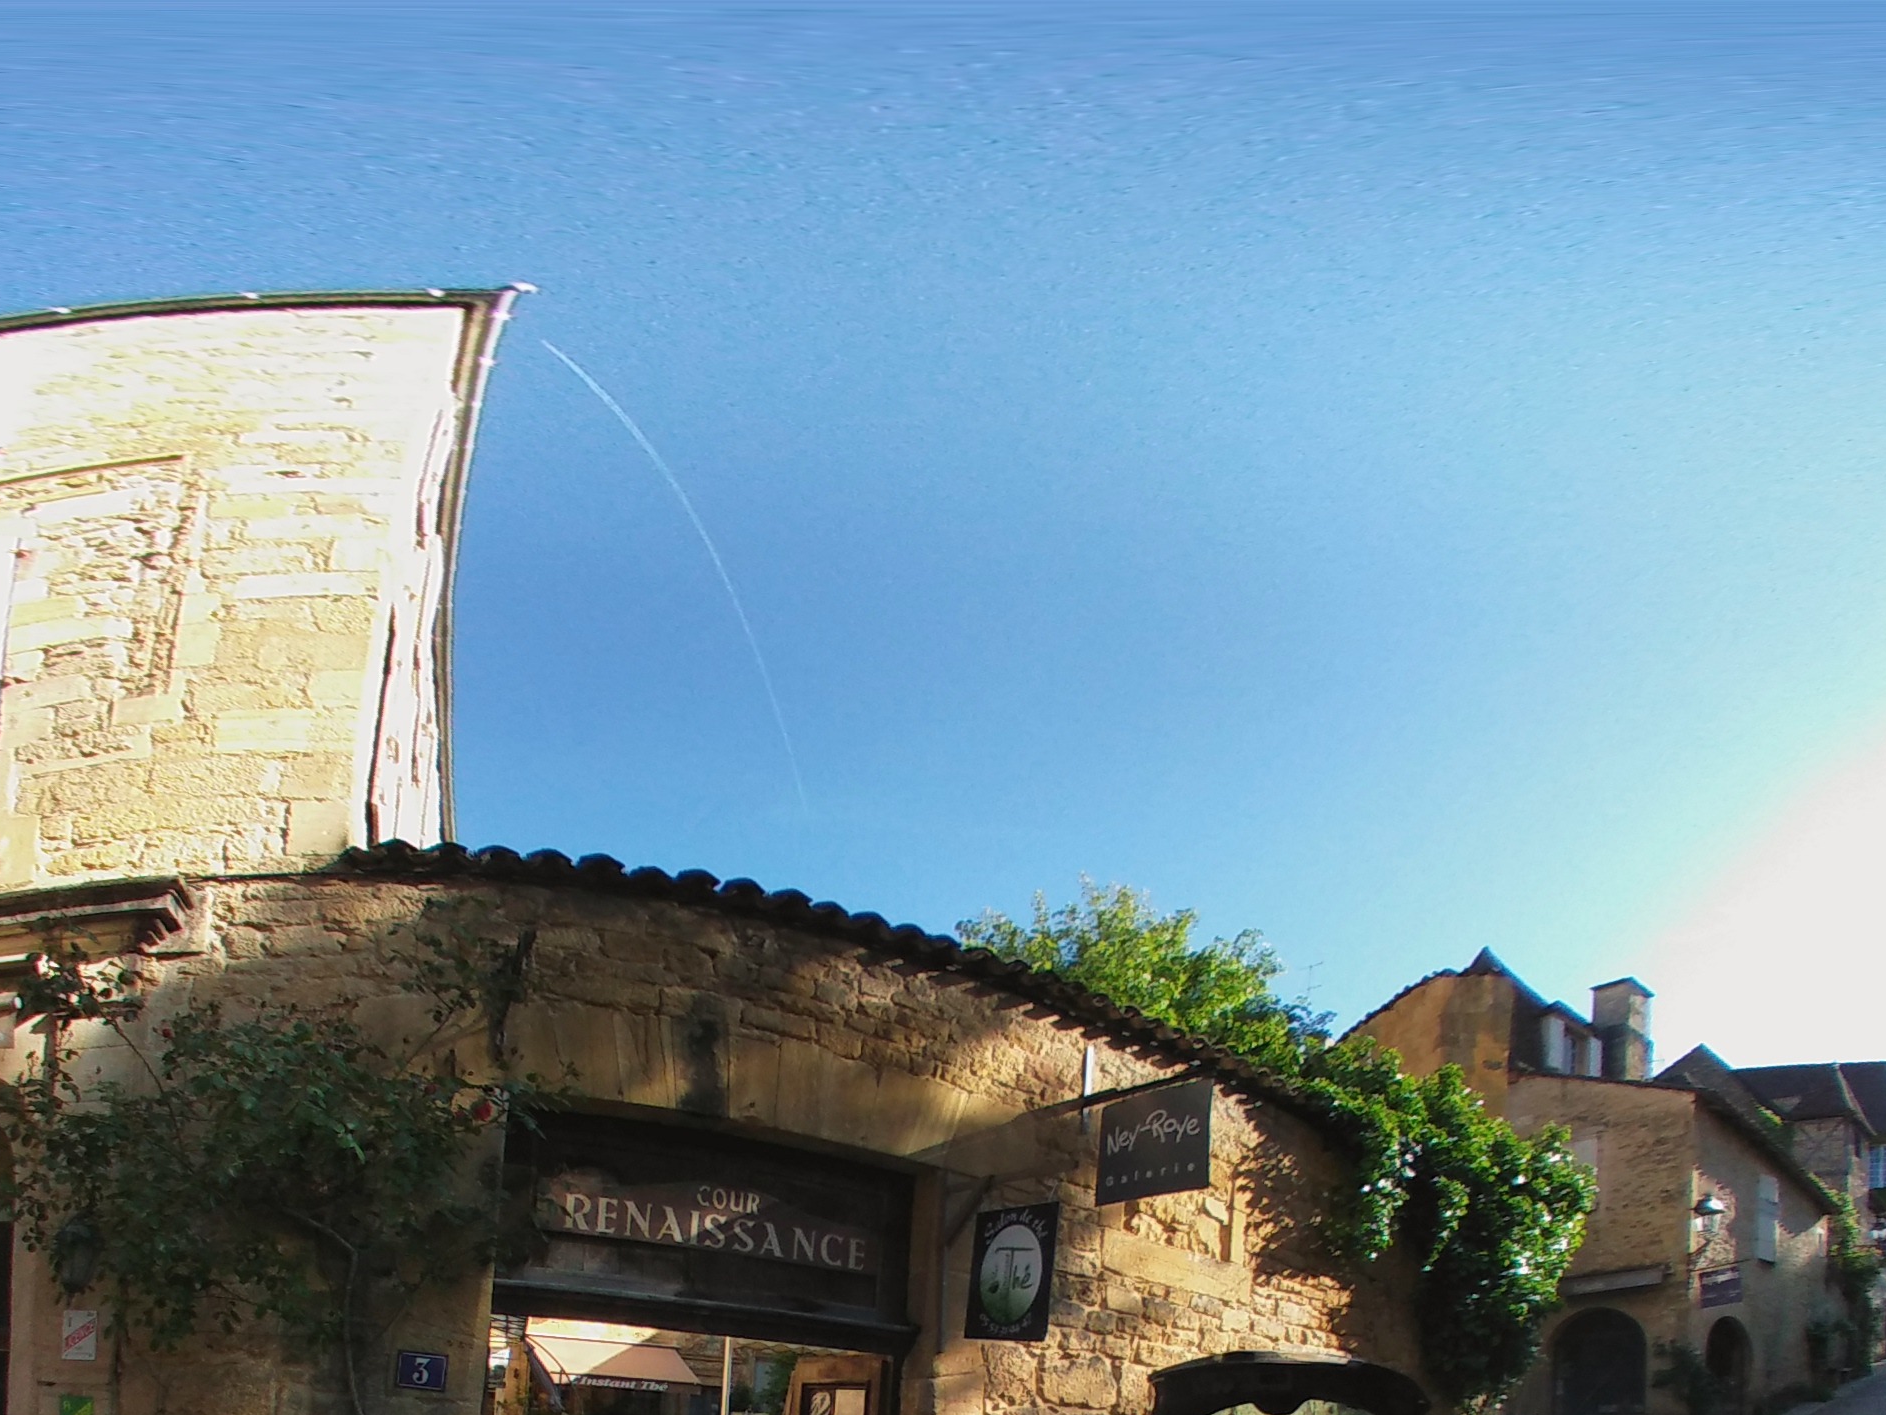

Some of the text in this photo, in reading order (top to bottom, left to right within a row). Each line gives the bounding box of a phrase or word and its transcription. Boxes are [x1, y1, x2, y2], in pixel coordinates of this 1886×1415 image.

[1106, 1109, 1201, 1156] Ney-Roye
[1105, 1162, 1196, 1187] Galerie
[696, 1185, 761, 1215] COUR
[563, 1191, 867, 1272] RENAISSANCE
[412, 1357, 431, 1385] 3
